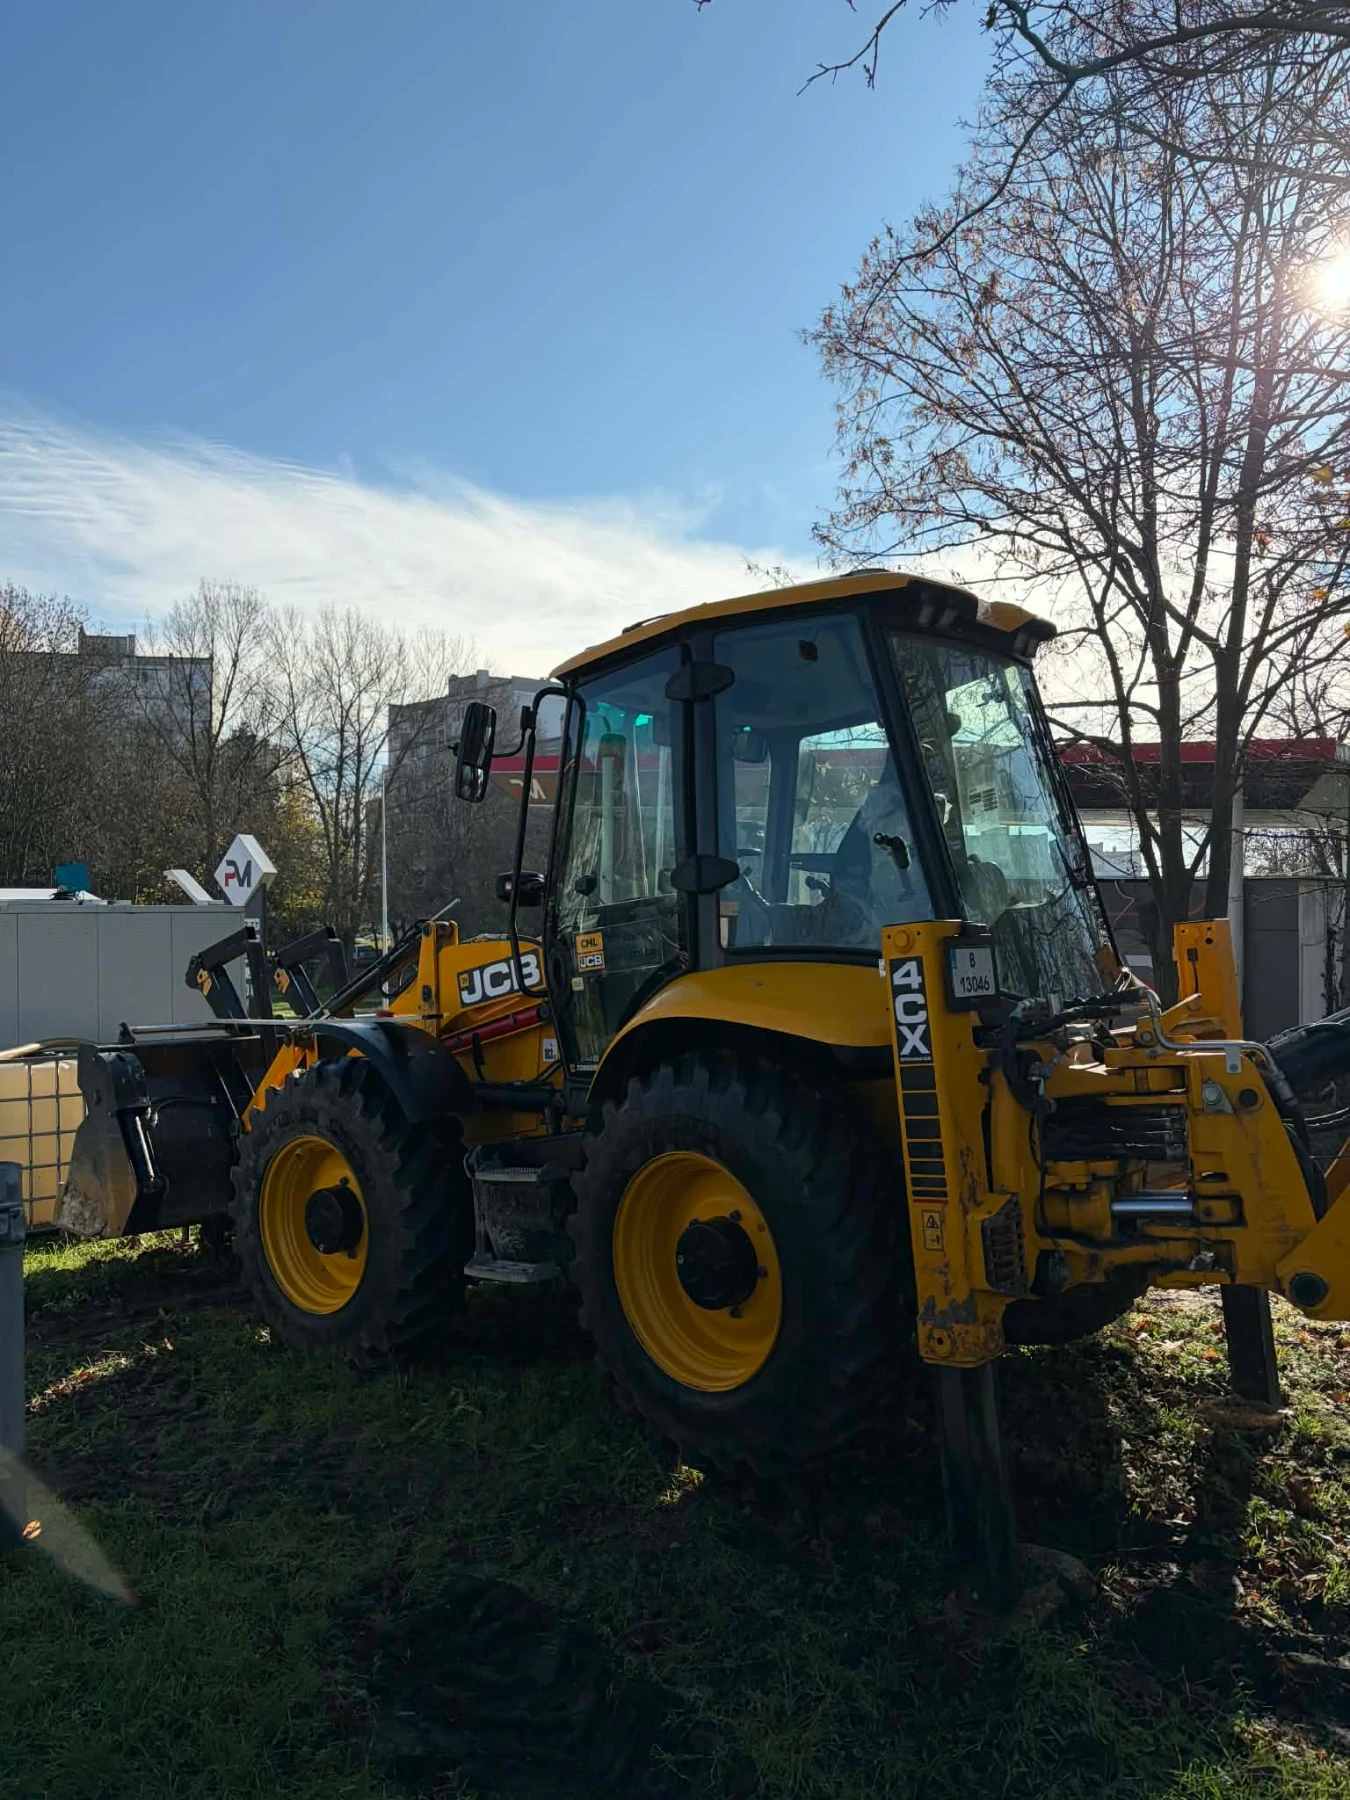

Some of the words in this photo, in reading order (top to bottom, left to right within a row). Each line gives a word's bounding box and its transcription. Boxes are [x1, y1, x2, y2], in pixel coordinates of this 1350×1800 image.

[225, 860, 252, 887] PM
[580, 937, 598, 949] CML
[580, 955, 603, 968] JCB
[969, 952, 976, 968] B
[461, 953, 541, 1004] JCB
[960, 976, 990, 993] 13046
[892, 960, 931, 1056] 4CX
